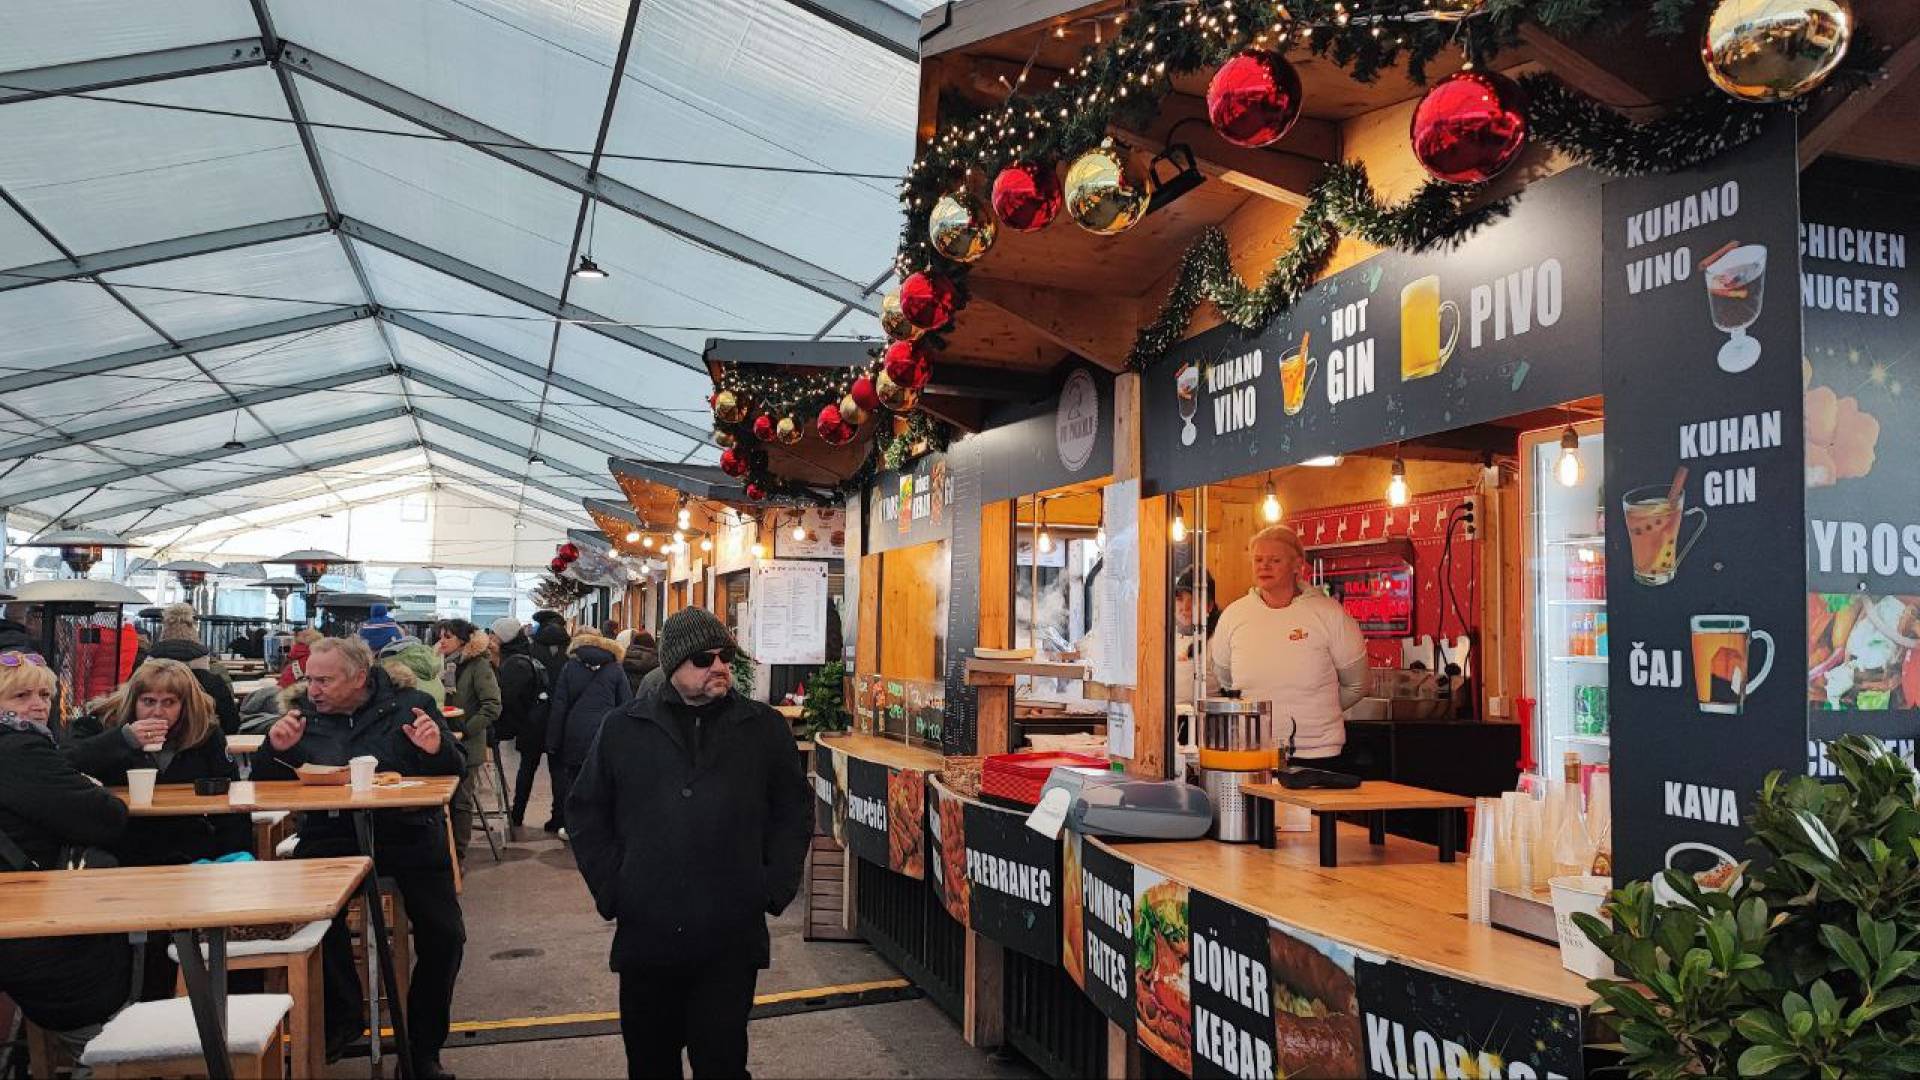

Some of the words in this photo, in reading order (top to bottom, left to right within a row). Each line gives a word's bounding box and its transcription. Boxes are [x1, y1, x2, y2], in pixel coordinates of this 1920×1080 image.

[1627, 181, 1740, 249] KUHANO
[1626, 247, 1691, 295] VINO
[1801, 273, 1900, 317] NUGETS
[1331, 298, 1369, 343] HOT
[1471, 258, 1562, 349] PIVO
[1208, 348, 1262, 394] KUHANO
[1327, 338, 1375, 404] GIN
[1214, 385, 1256, 435] VINO
[1680, 410, 1781, 460] KUHAN
[1704, 466, 1756, 507] GIN
[1629, 641, 1683, 688] ČAJ
[1664, 780, 1740, 827] KAVA
[966, 847, 1051, 907] PREBRANEC
[1082, 867, 1132, 940] POMMES
[1087, 929, 1128, 1000] FRITES
[1193, 926, 1270, 1018] DÖNER
